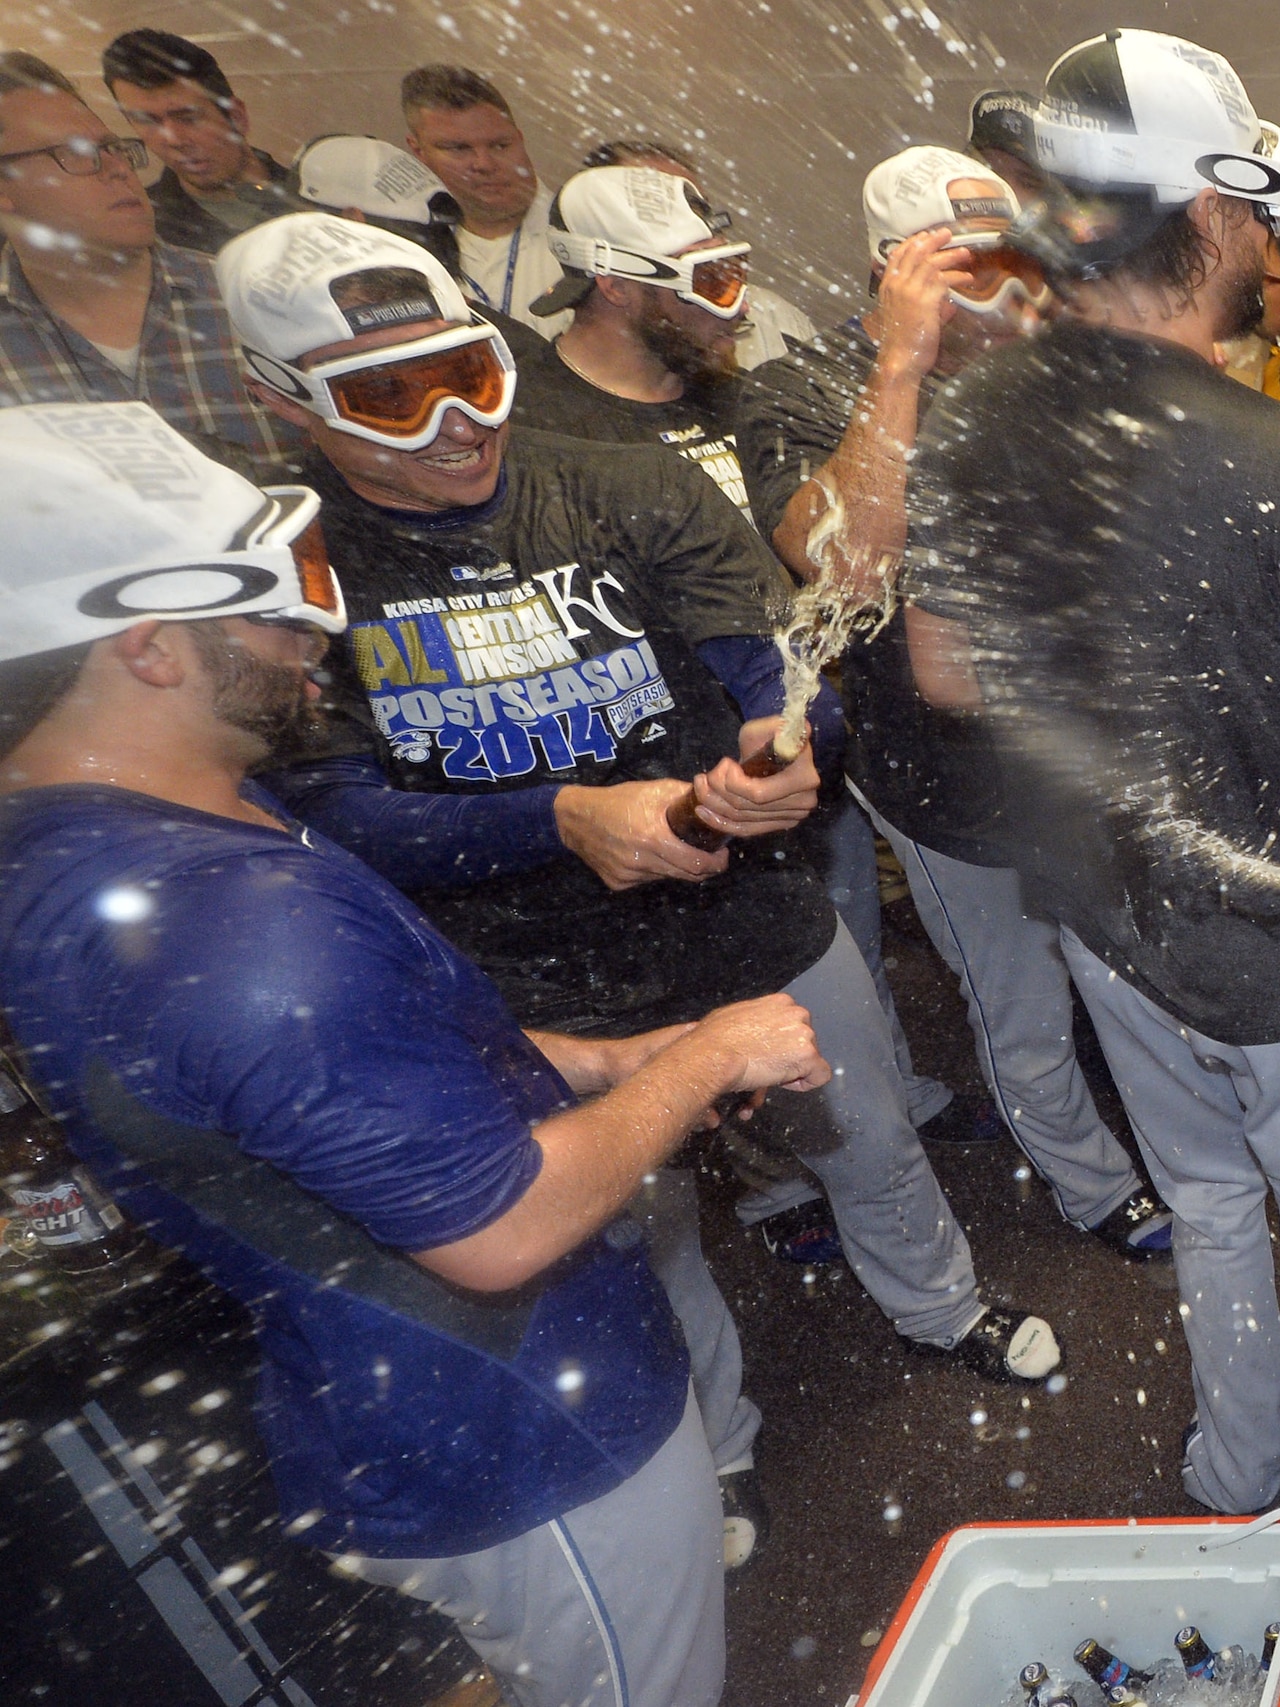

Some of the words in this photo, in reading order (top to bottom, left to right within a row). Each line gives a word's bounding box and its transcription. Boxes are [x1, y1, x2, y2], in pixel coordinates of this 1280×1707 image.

[374, 300, 431, 323] POSTSEASON
[383, 597, 448, 619] KANSA
[447, 594, 483, 611] CITY
[532, 562, 645, 640] KC
[352, 620, 449, 692] AL
[436, 705, 618, 783] 2014
[30, 1205, 86, 1232] GHT
